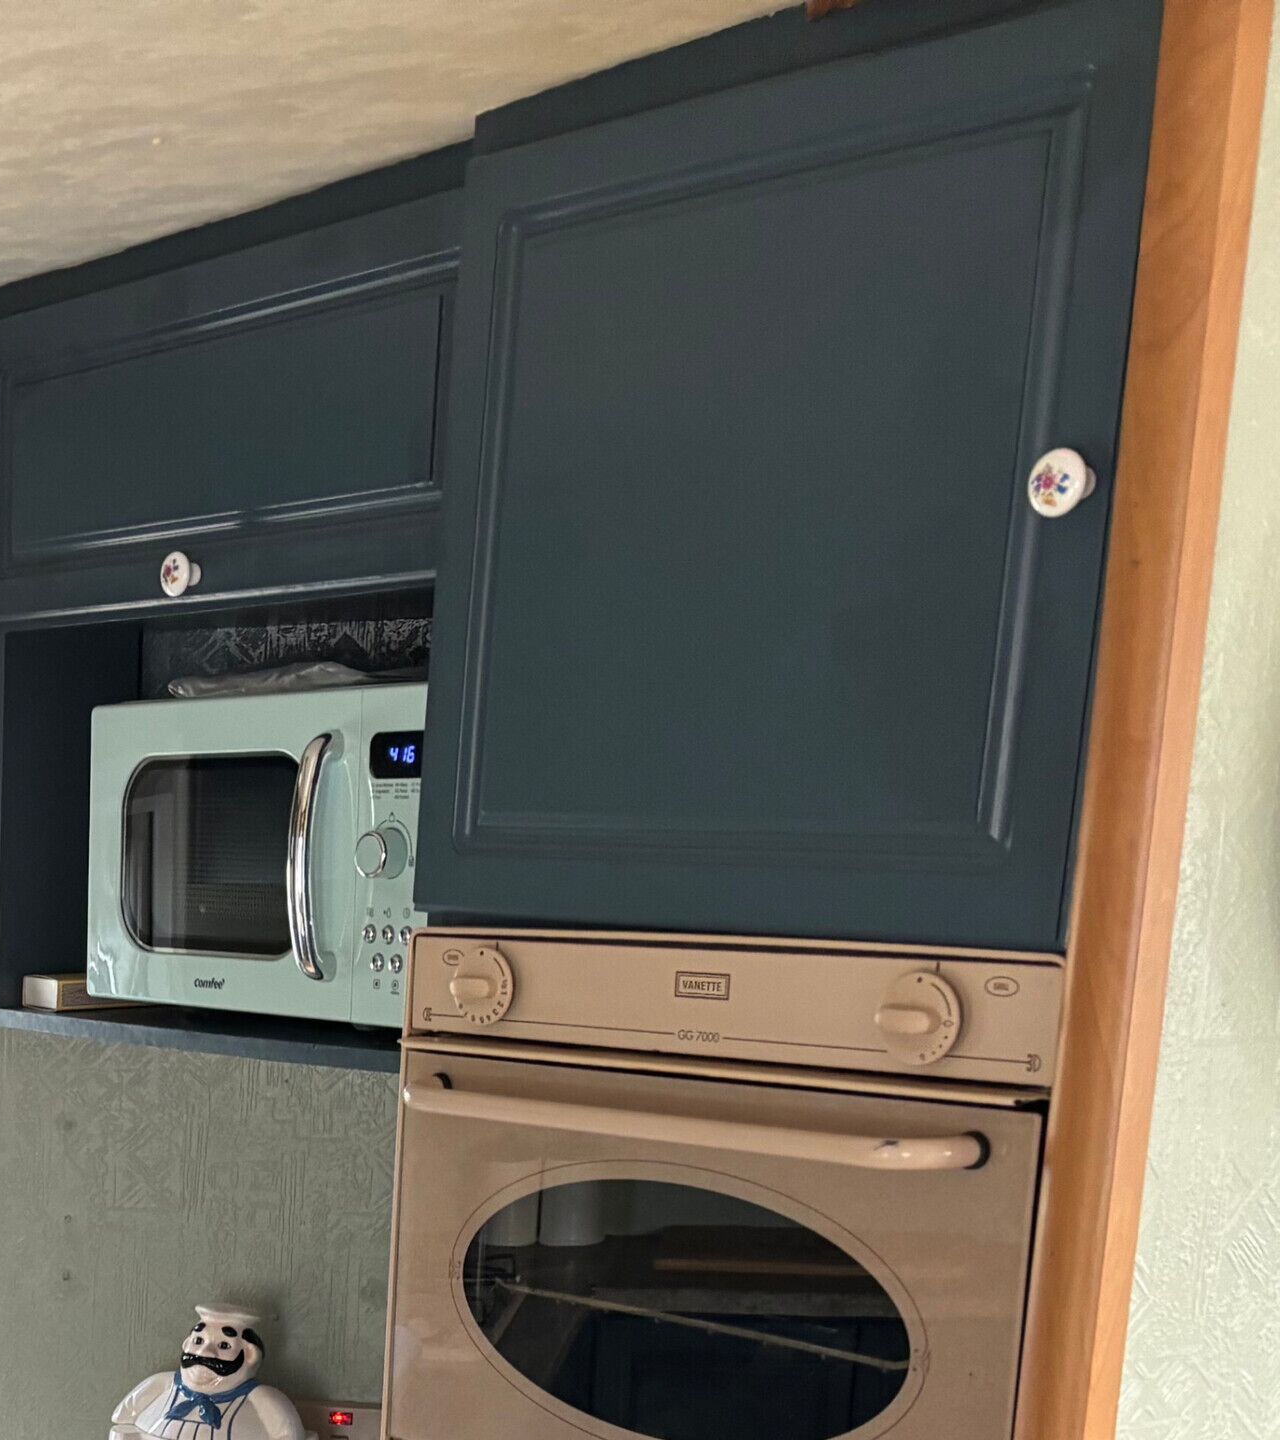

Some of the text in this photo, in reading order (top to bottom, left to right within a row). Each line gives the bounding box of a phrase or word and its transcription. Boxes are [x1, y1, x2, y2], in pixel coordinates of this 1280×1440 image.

[682, 980, 723, 992] VANETTE
[677, 1029, 720, 1043] GG 7000
